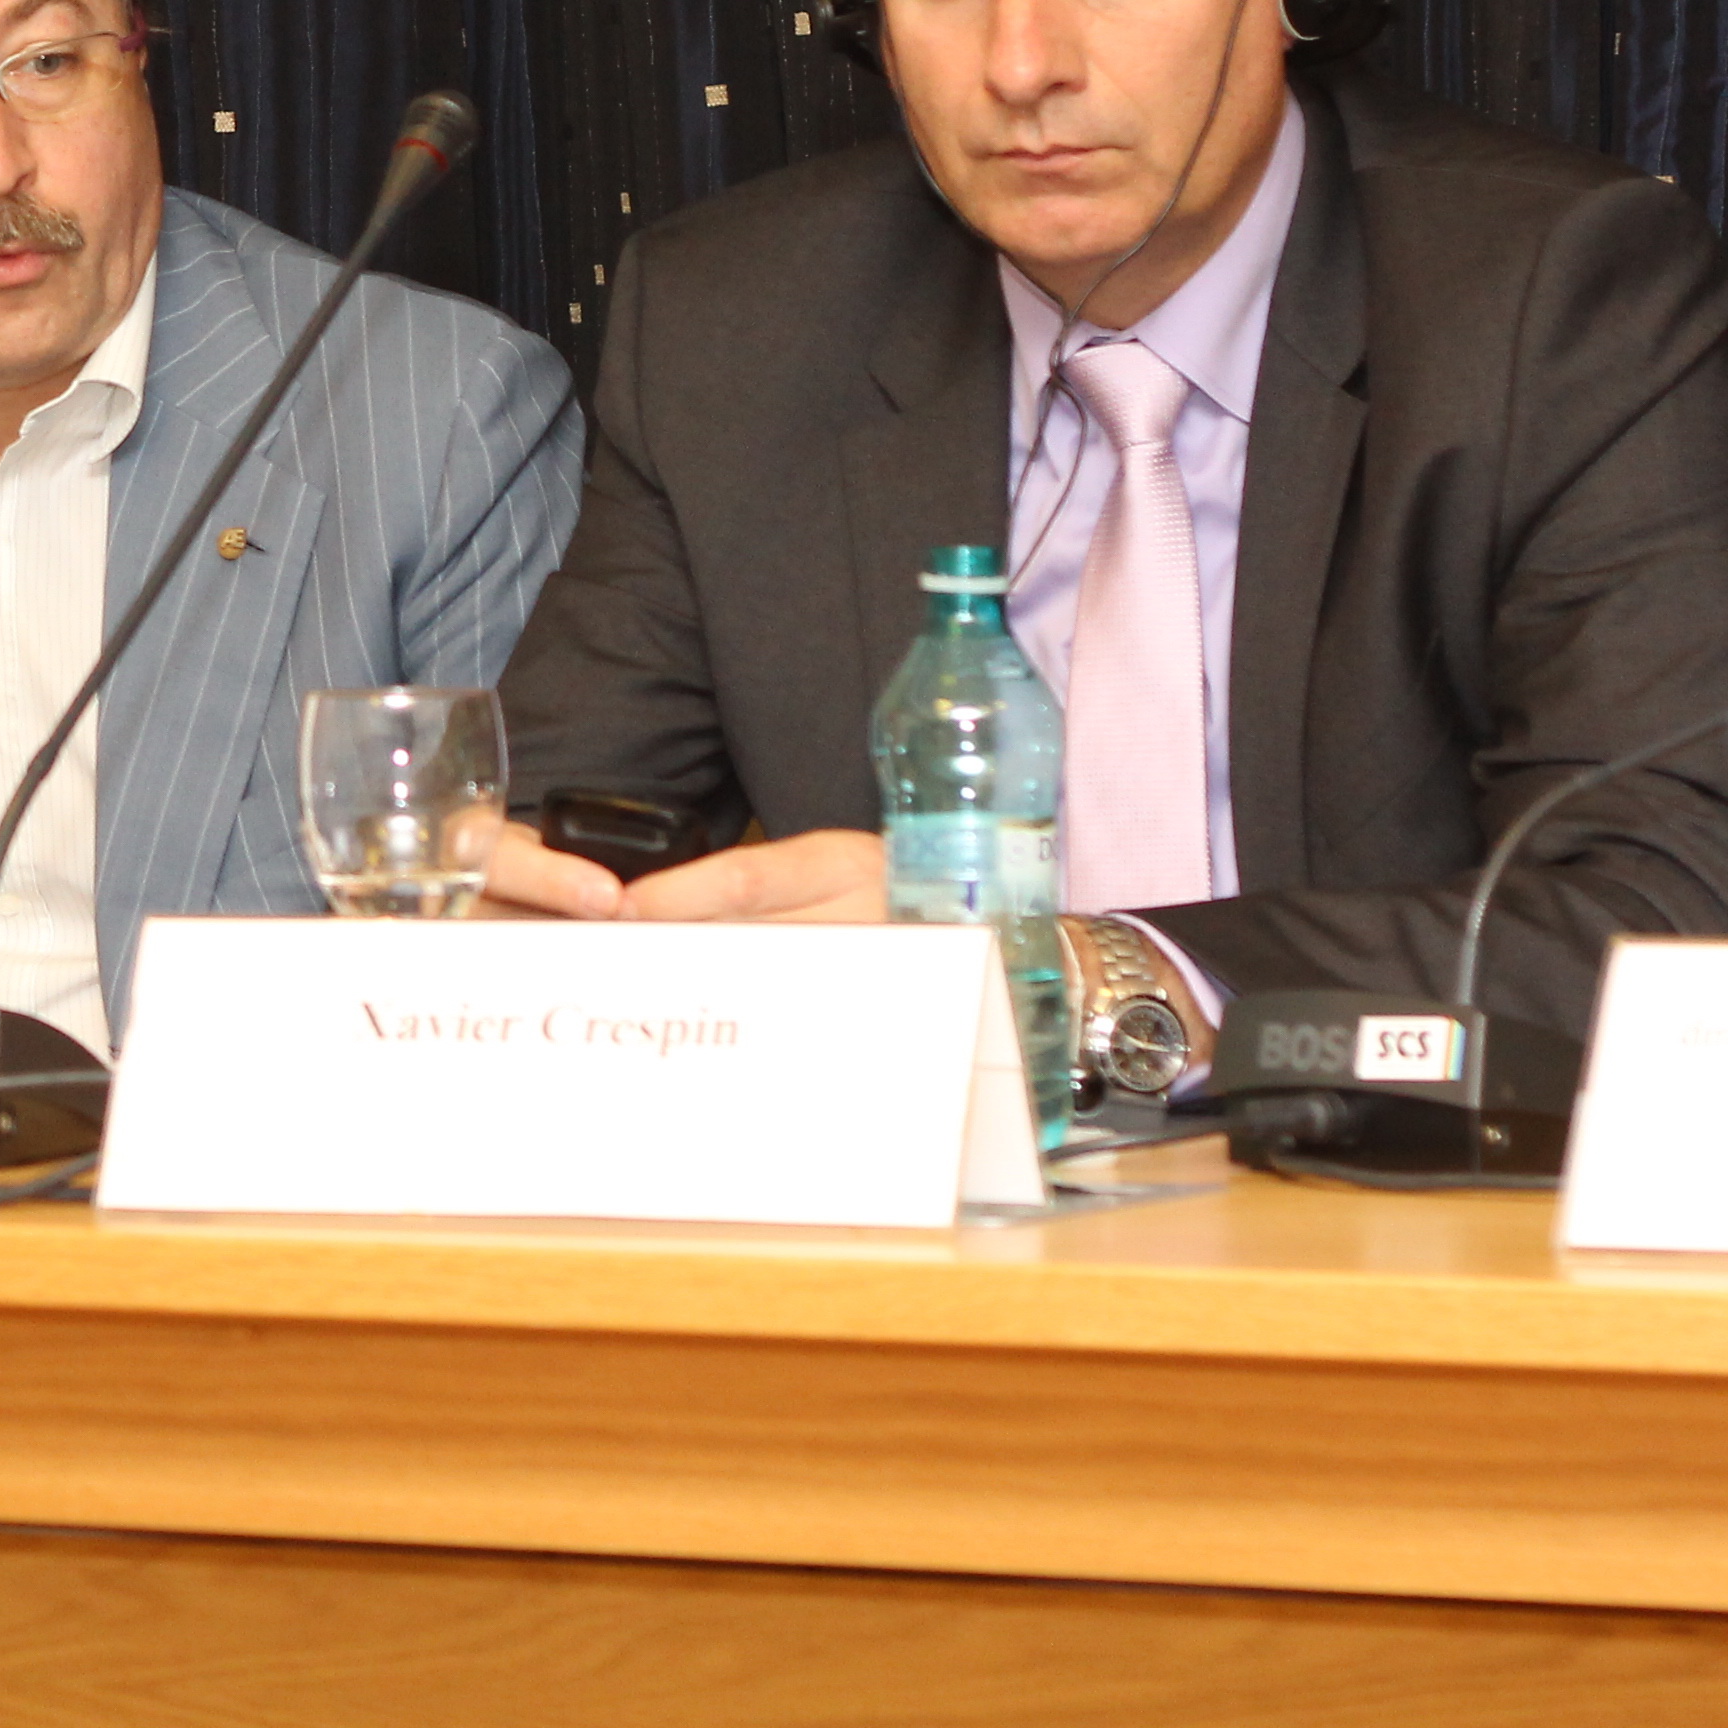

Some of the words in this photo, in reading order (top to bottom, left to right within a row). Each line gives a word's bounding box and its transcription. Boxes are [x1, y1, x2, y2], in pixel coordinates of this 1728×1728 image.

[352, 1000, 525, 1043] Xavier
[539, 1002, 741, 1058] Crespin
[1376, 1030, 1432, 1060] SCS
